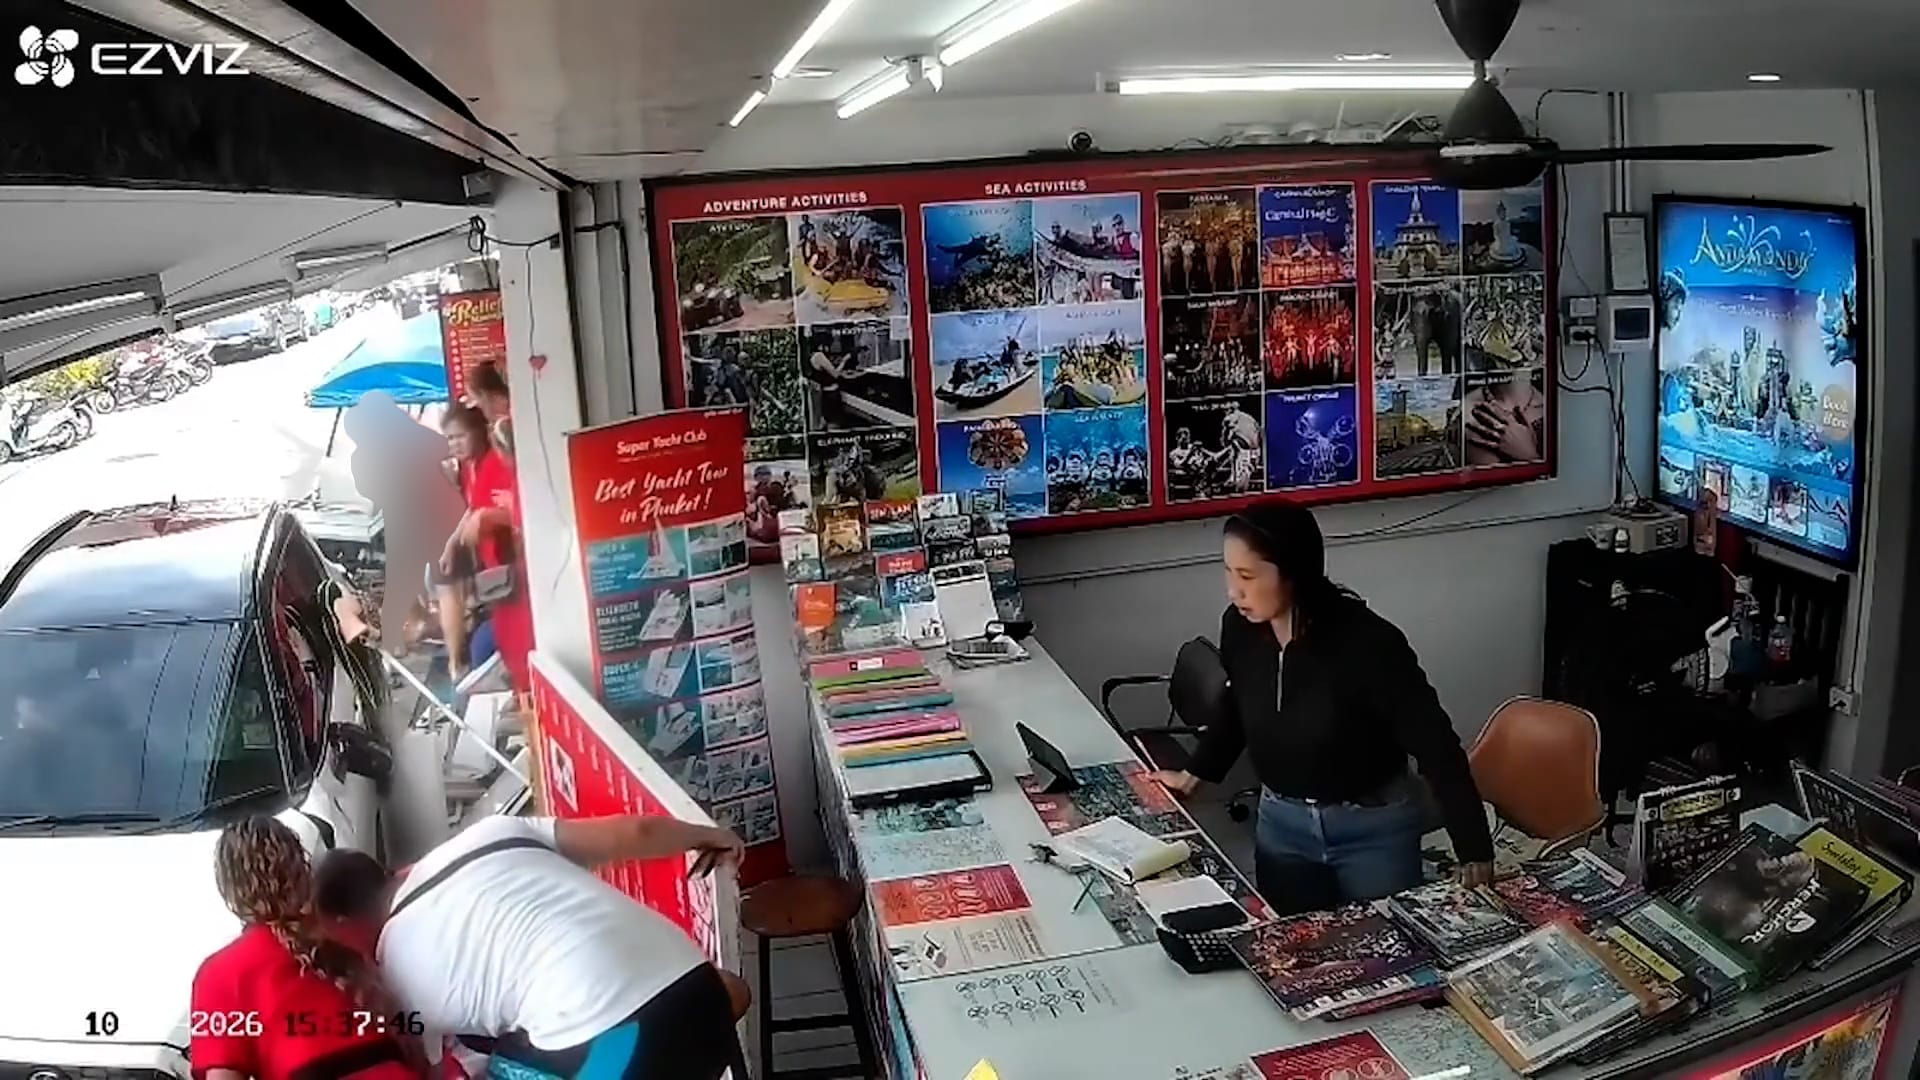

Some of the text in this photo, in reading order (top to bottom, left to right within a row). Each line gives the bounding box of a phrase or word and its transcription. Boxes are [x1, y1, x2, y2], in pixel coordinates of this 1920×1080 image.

[985, 179, 1088, 196] SEA ACTIVITIES
[703, 191, 868, 213] ADVENTURE ACTIVITIES
[616, 428, 707, 456] Super Yacht Club
[594, 461, 729, 503] Best Yacht Tour
[619, 507, 638, 524] in
